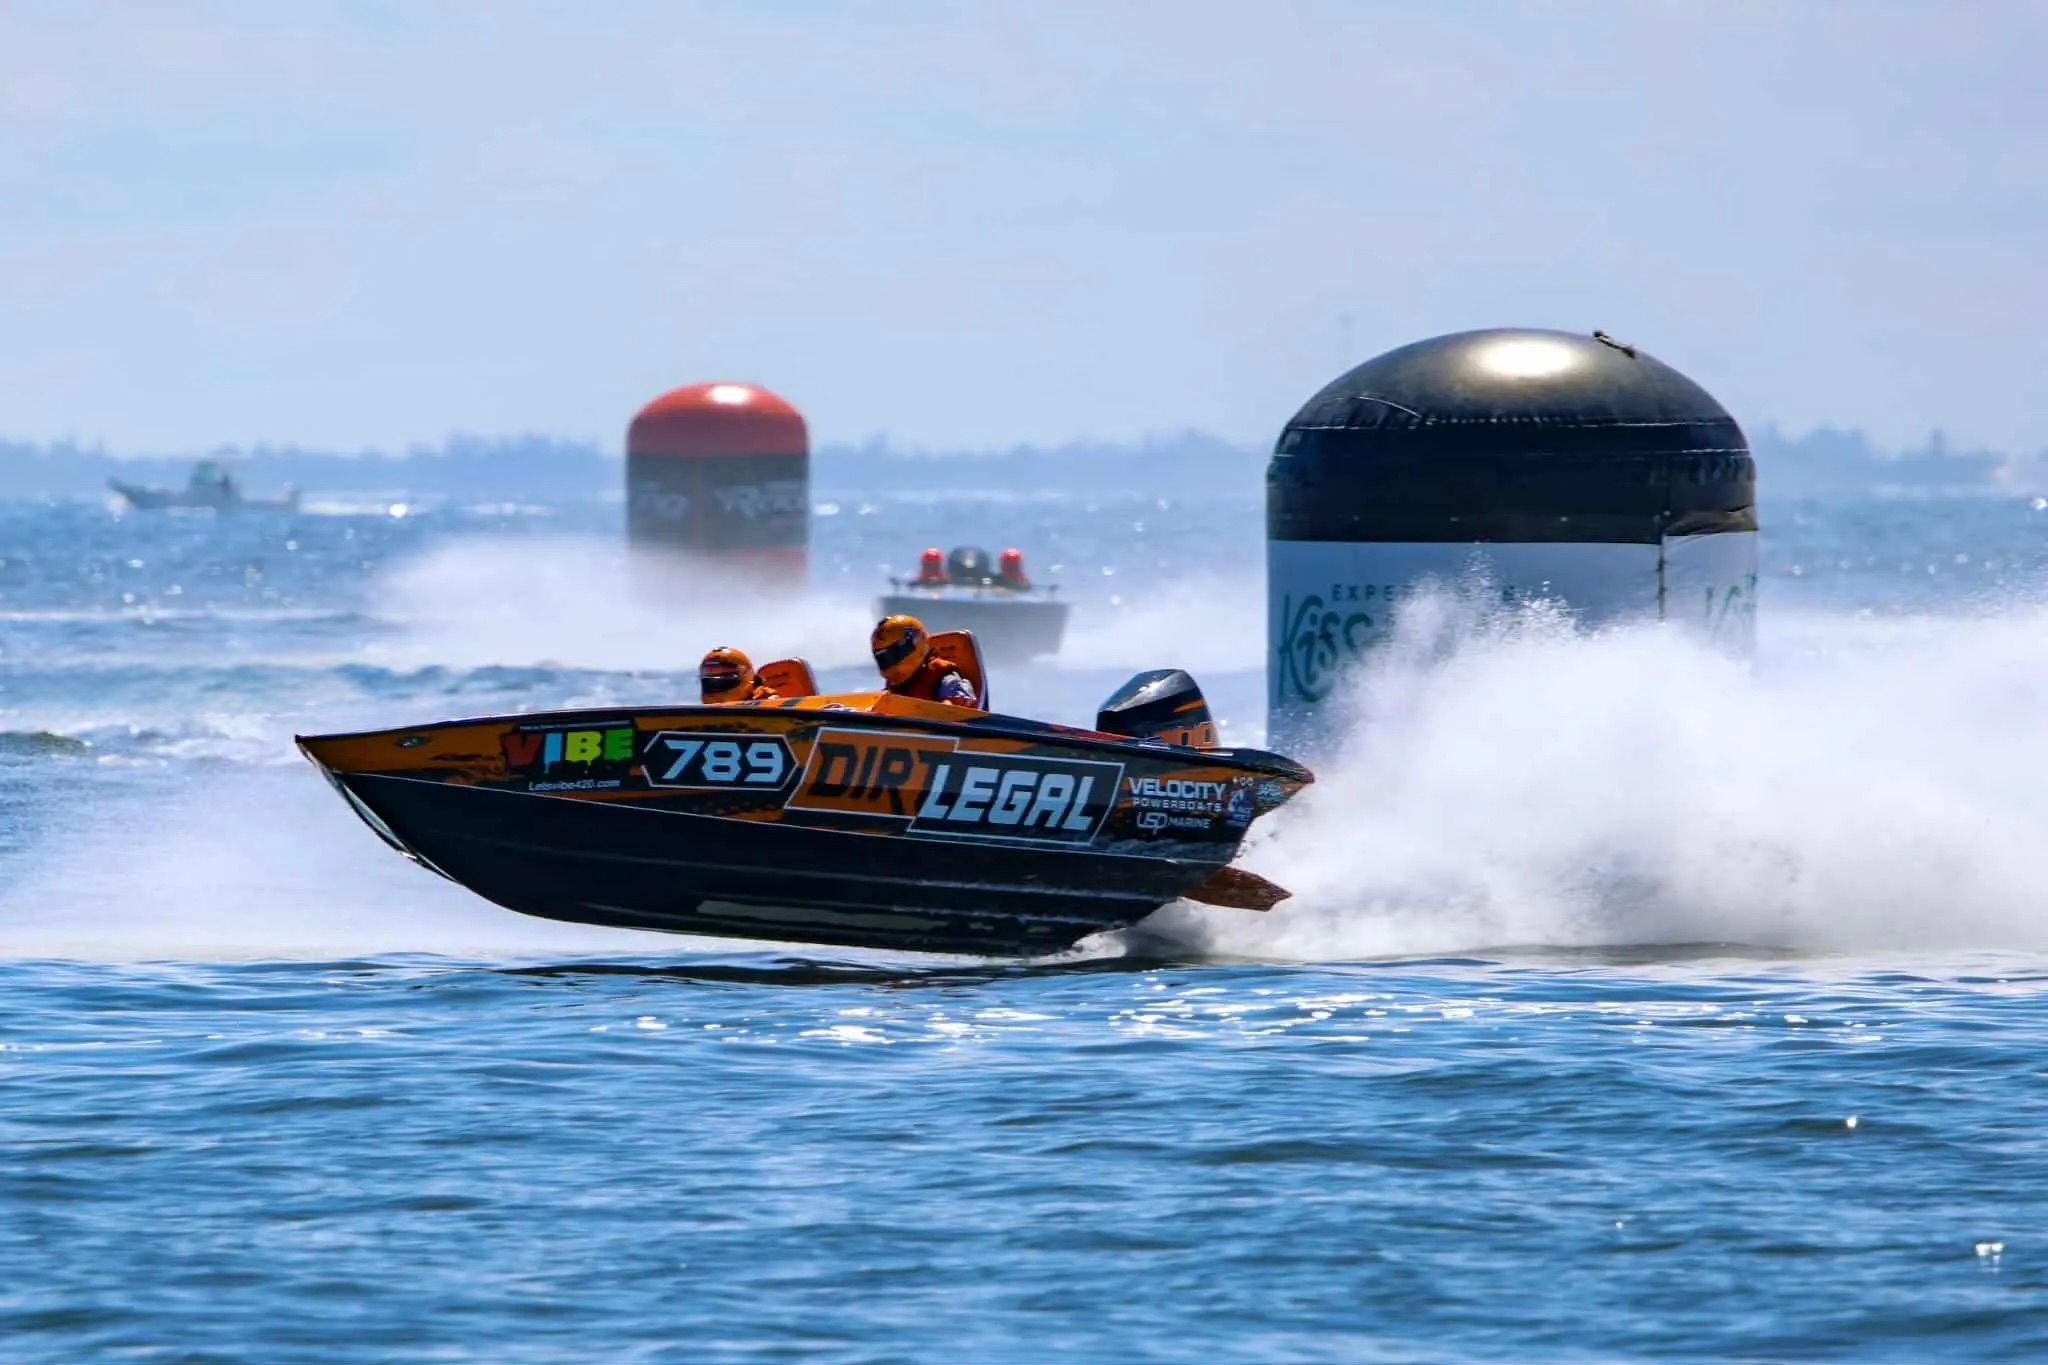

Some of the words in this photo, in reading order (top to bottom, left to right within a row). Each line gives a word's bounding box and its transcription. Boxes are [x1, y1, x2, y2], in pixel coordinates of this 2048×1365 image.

[503, 728, 634, 770] VIBE
[662, 739, 784, 783] 789
[916, 764, 1094, 831] LEGAL
[1128, 777, 1226, 800] VELOCITY
[1132, 797, 1223, 812] POWERBOATS
[1168, 816, 1212, 829] MARINE
